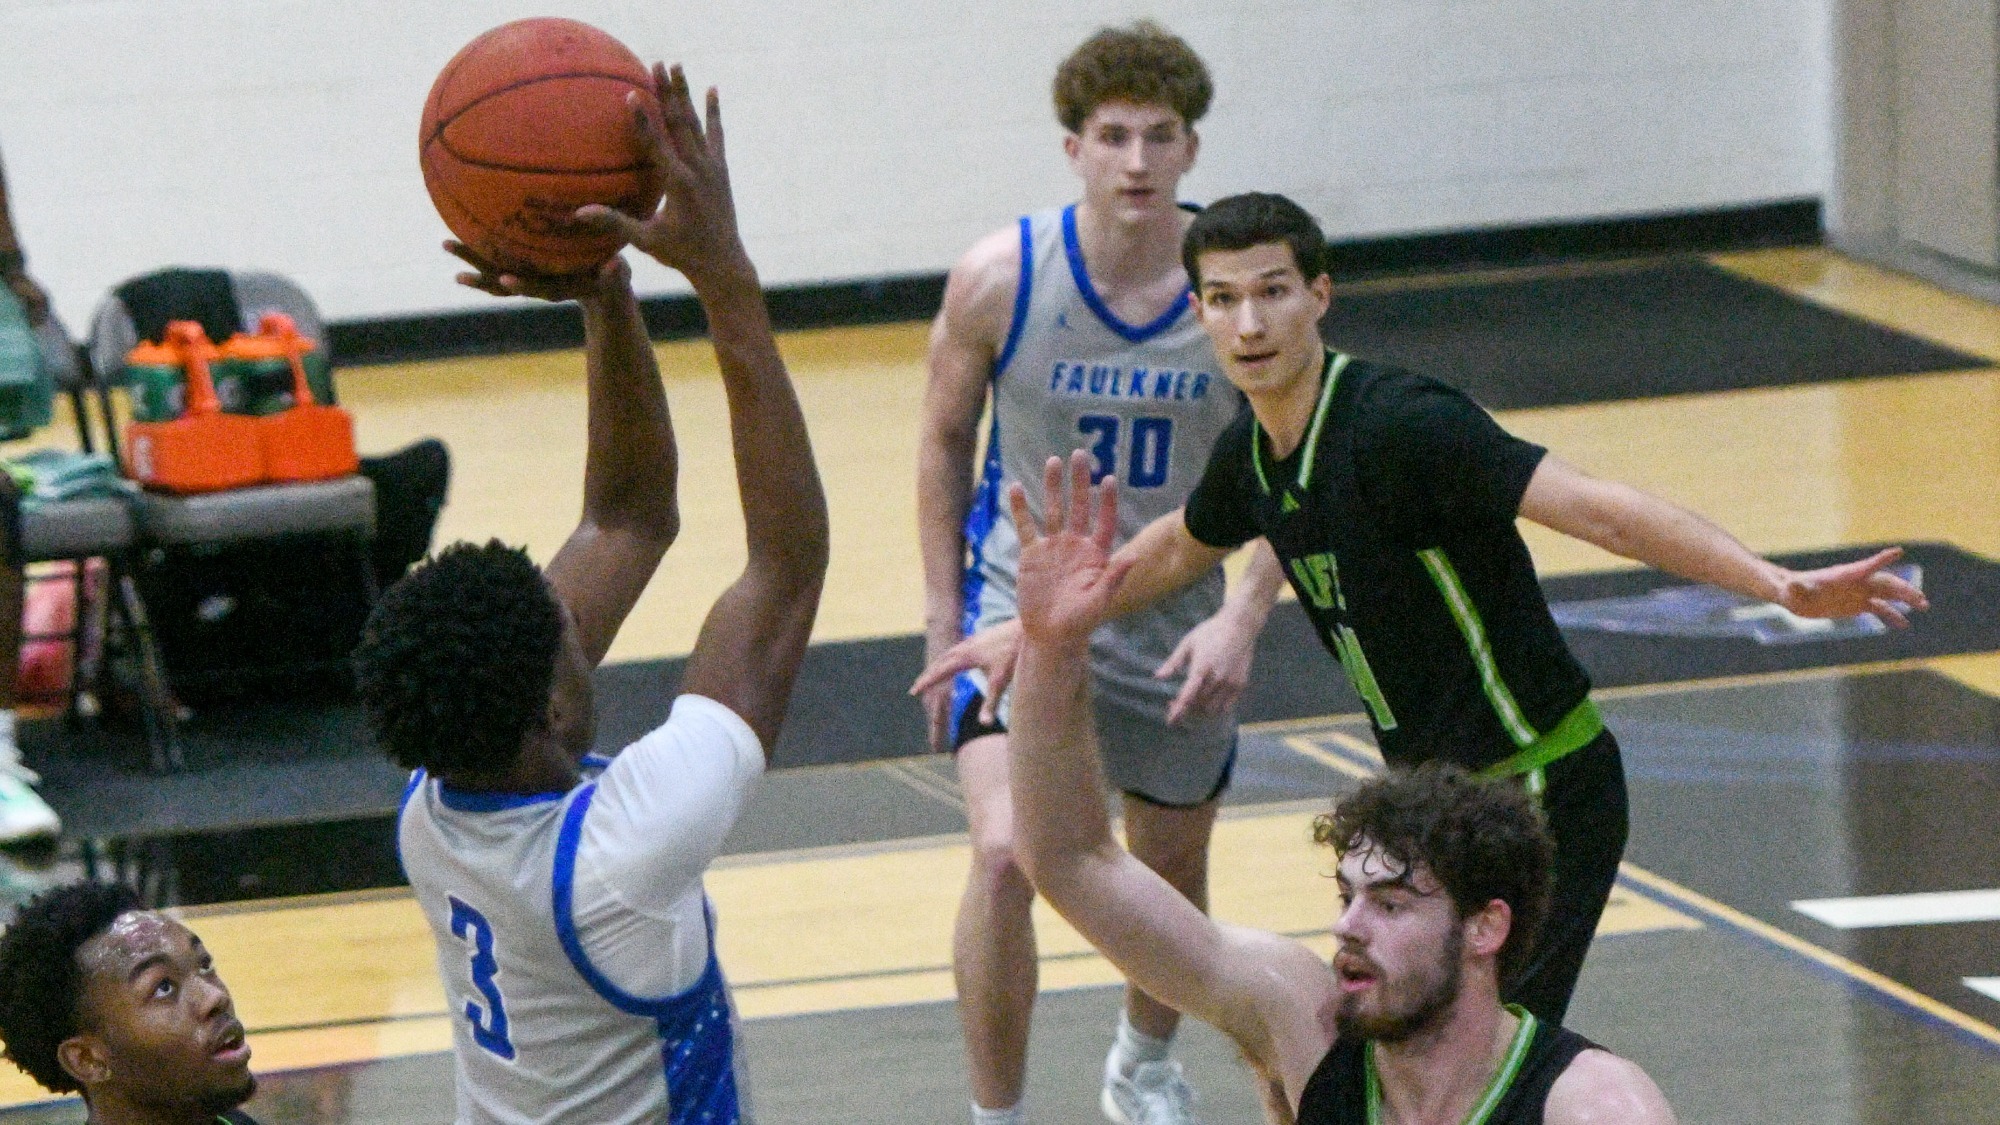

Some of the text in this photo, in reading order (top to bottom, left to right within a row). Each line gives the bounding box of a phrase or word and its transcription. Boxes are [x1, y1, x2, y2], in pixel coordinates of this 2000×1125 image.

[1052, 361, 1209, 399] FAULKNER
[1078, 415, 1172, 487] 30
[449, 894, 516, 1061] 3
